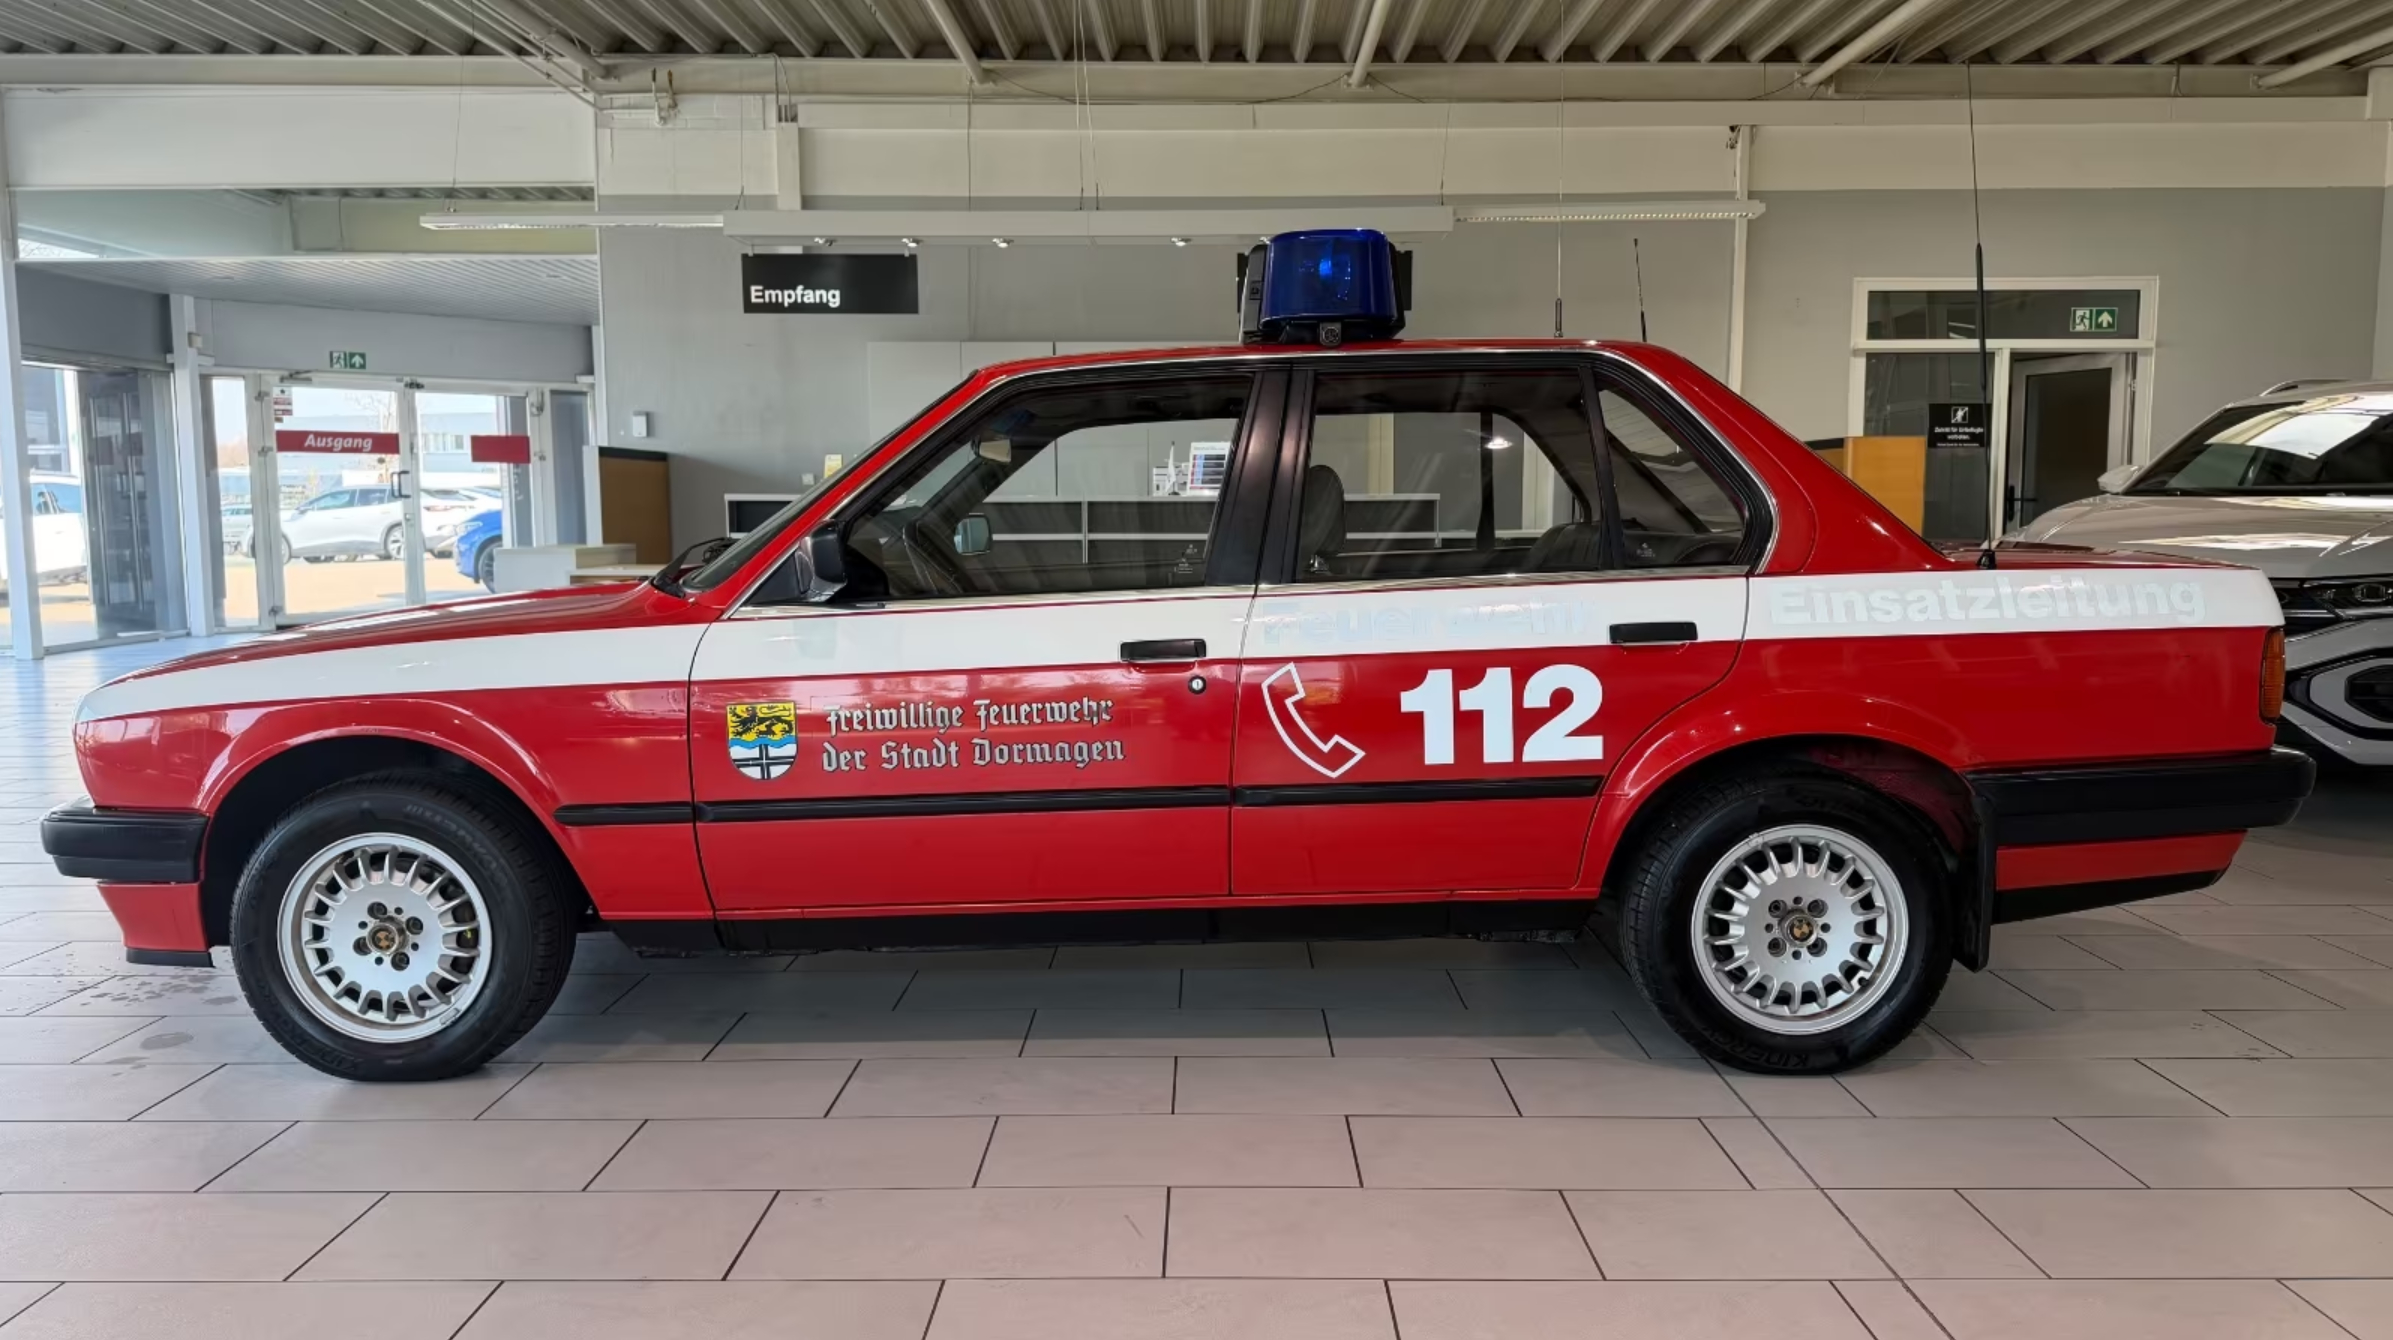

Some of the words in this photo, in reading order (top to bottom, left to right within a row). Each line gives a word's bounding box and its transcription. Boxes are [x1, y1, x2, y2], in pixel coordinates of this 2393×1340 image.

[749, 285, 841, 308] Empfang
[304, 434, 373, 453] Ausgang
[1769, 575, 2206, 625] Einsatzleitung
[822, 701, 964, 737] Freiwillige
[972, 696, 1114, 732] Feuerwehr
[1400, 664, 1604, 766] 112
[822, 741, 867, 772] der
[880, 737, 960, 770] Stadt
[971, 737, 1125, 768] Dormagen
